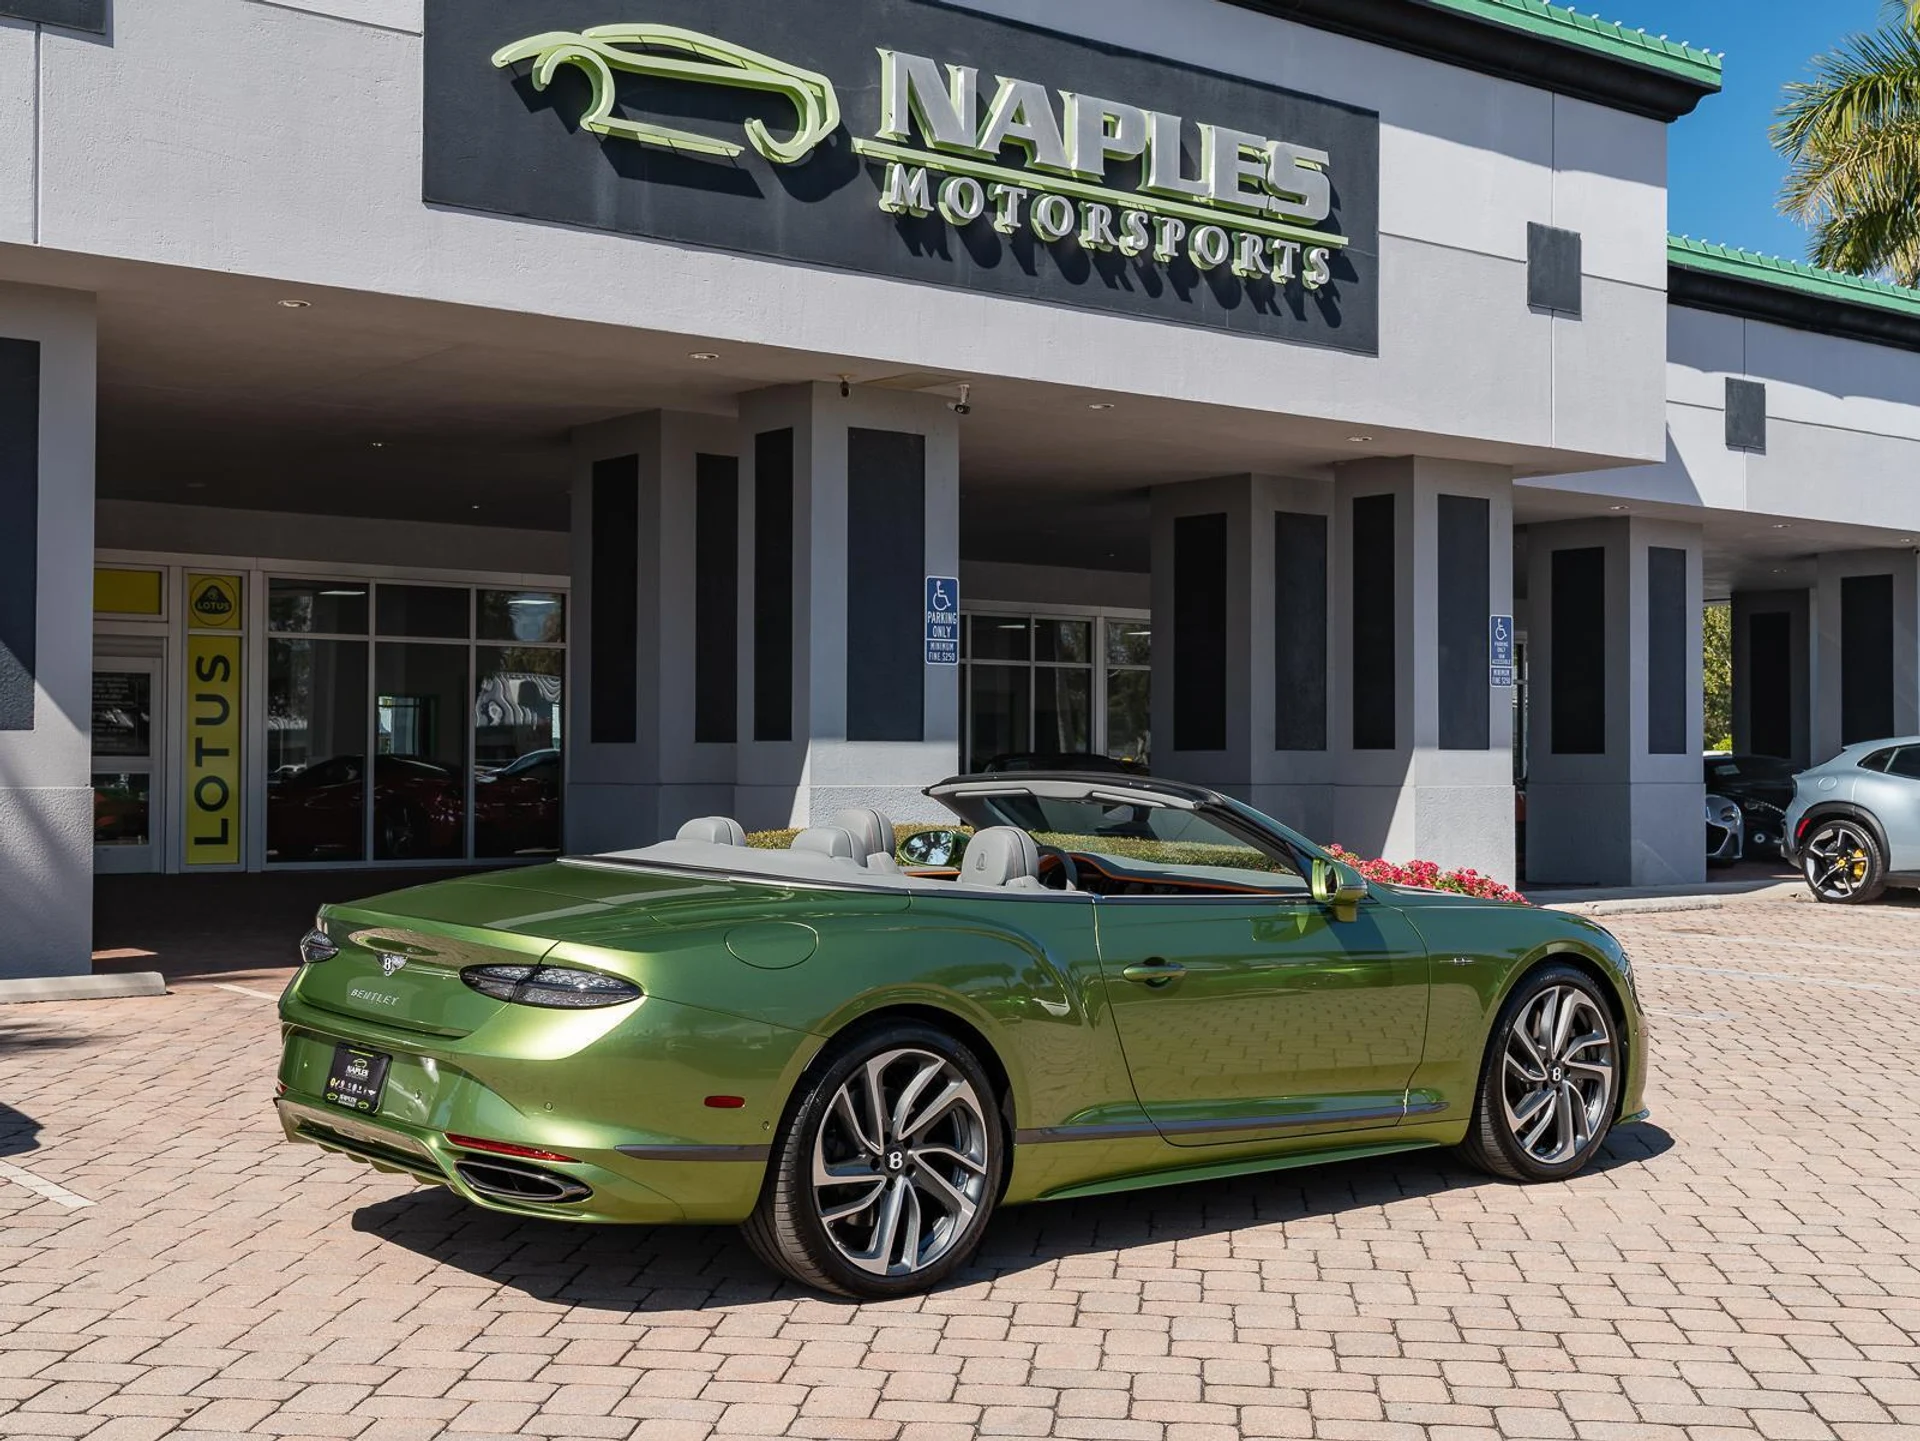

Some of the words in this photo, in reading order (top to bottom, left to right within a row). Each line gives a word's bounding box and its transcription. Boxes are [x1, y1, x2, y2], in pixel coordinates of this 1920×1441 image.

[875, 47, 1330, 225] NAPLES
[879, 162, 1330, 289] MOTORSPORTS
[196, 601, 230, 611] LOTUS
[927, 611, 957, 625] PARKING
[932, 625, 952, 638] ONLY
[930, 641, 954, 651] MINIMUM
[928, 651, 941, 661] FINE
[194, 654, 231, 846] LOTUS
[350, 988, 400, 1007] BENTLEY
[889, 1151, 904, 1169] B
